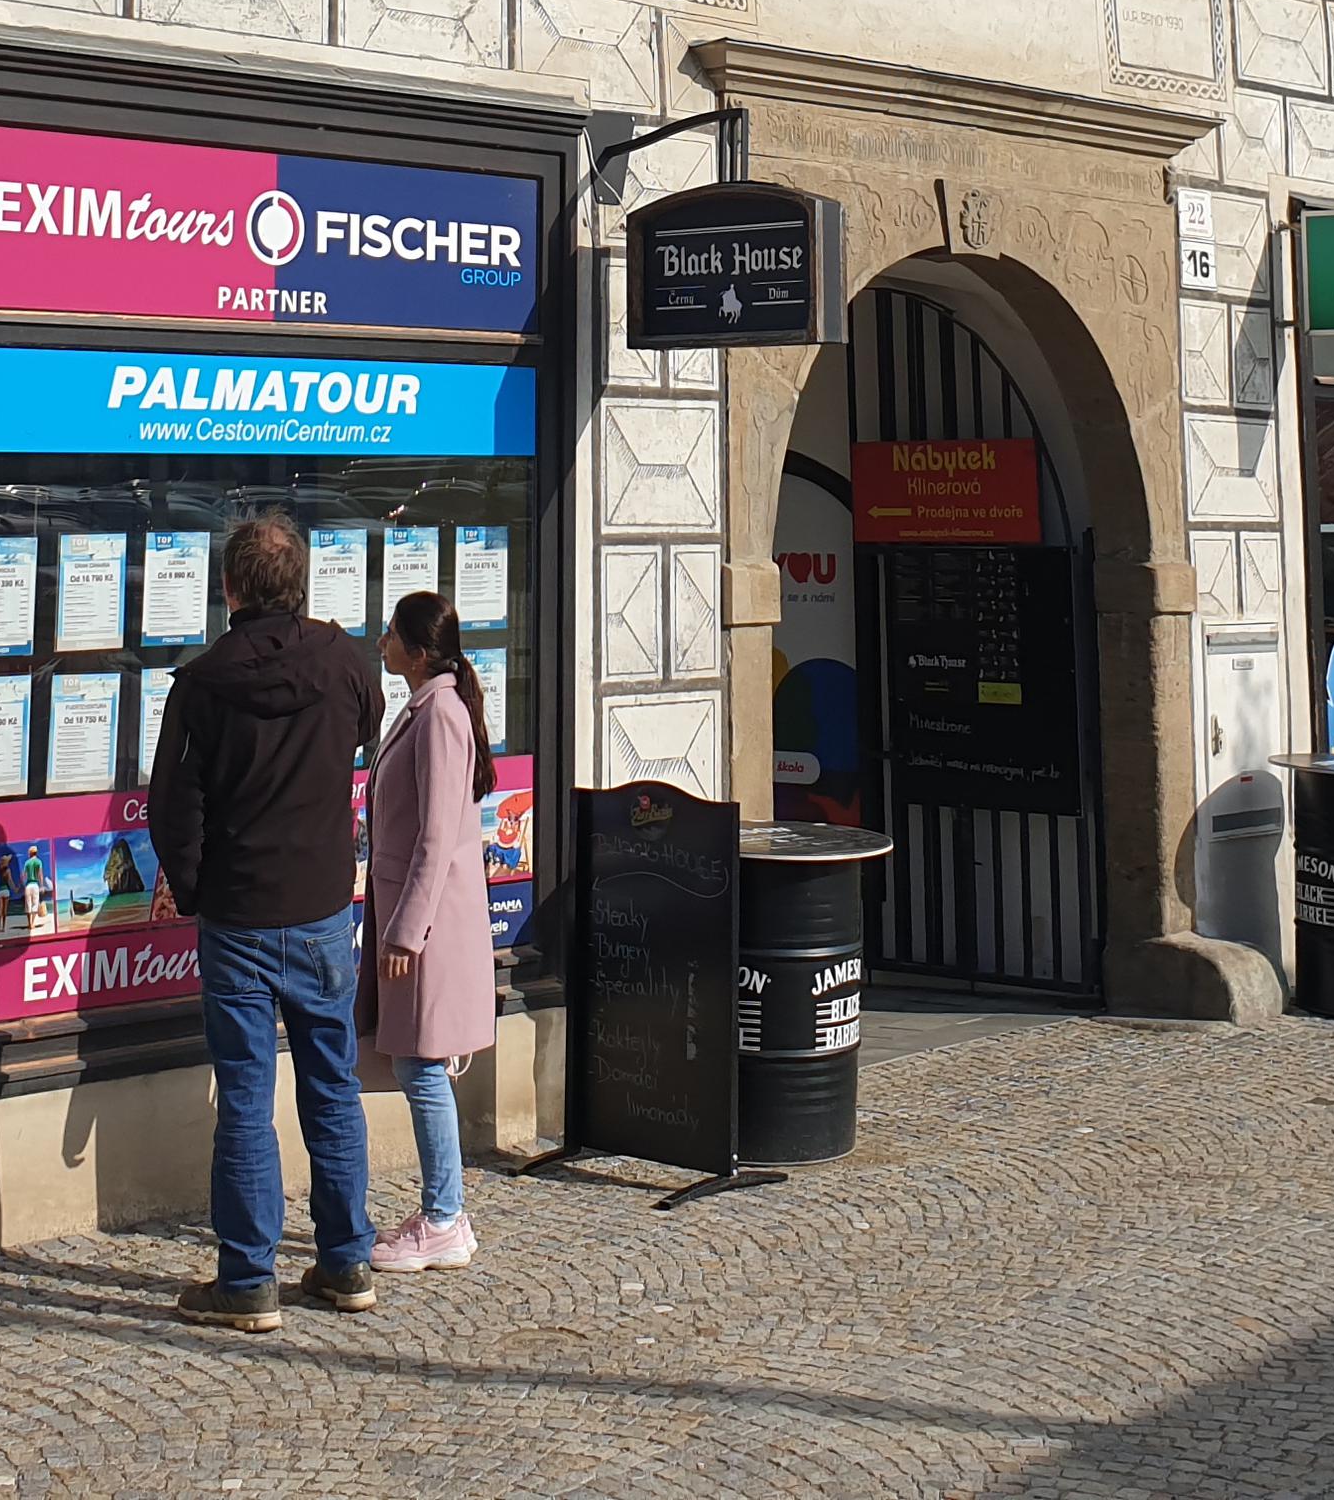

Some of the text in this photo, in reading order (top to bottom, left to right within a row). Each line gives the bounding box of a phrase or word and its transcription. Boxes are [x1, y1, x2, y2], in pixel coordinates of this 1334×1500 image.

[1188, 202, 1205, 224] 22
[316, 210, 522, 267] FISCHER
[655, 242, 803, 276] Black House
[1187, 250, 1210, 278] 16
[461, 268, 521, 287] GROUP
[217, 285, 328, 315] PARTNER
[108, 365, 420, 414] PALMATOUR
[139, 417, 392, 443] www.CestovniCentrum.cz
[892, 443, 996, 478] Nábytek
[907, 477, 981, 496] Klinerová
[917, 505, 1023, 520] Prodejna ve dvoře
[23, 943, 202, 1002] EXIMtour
